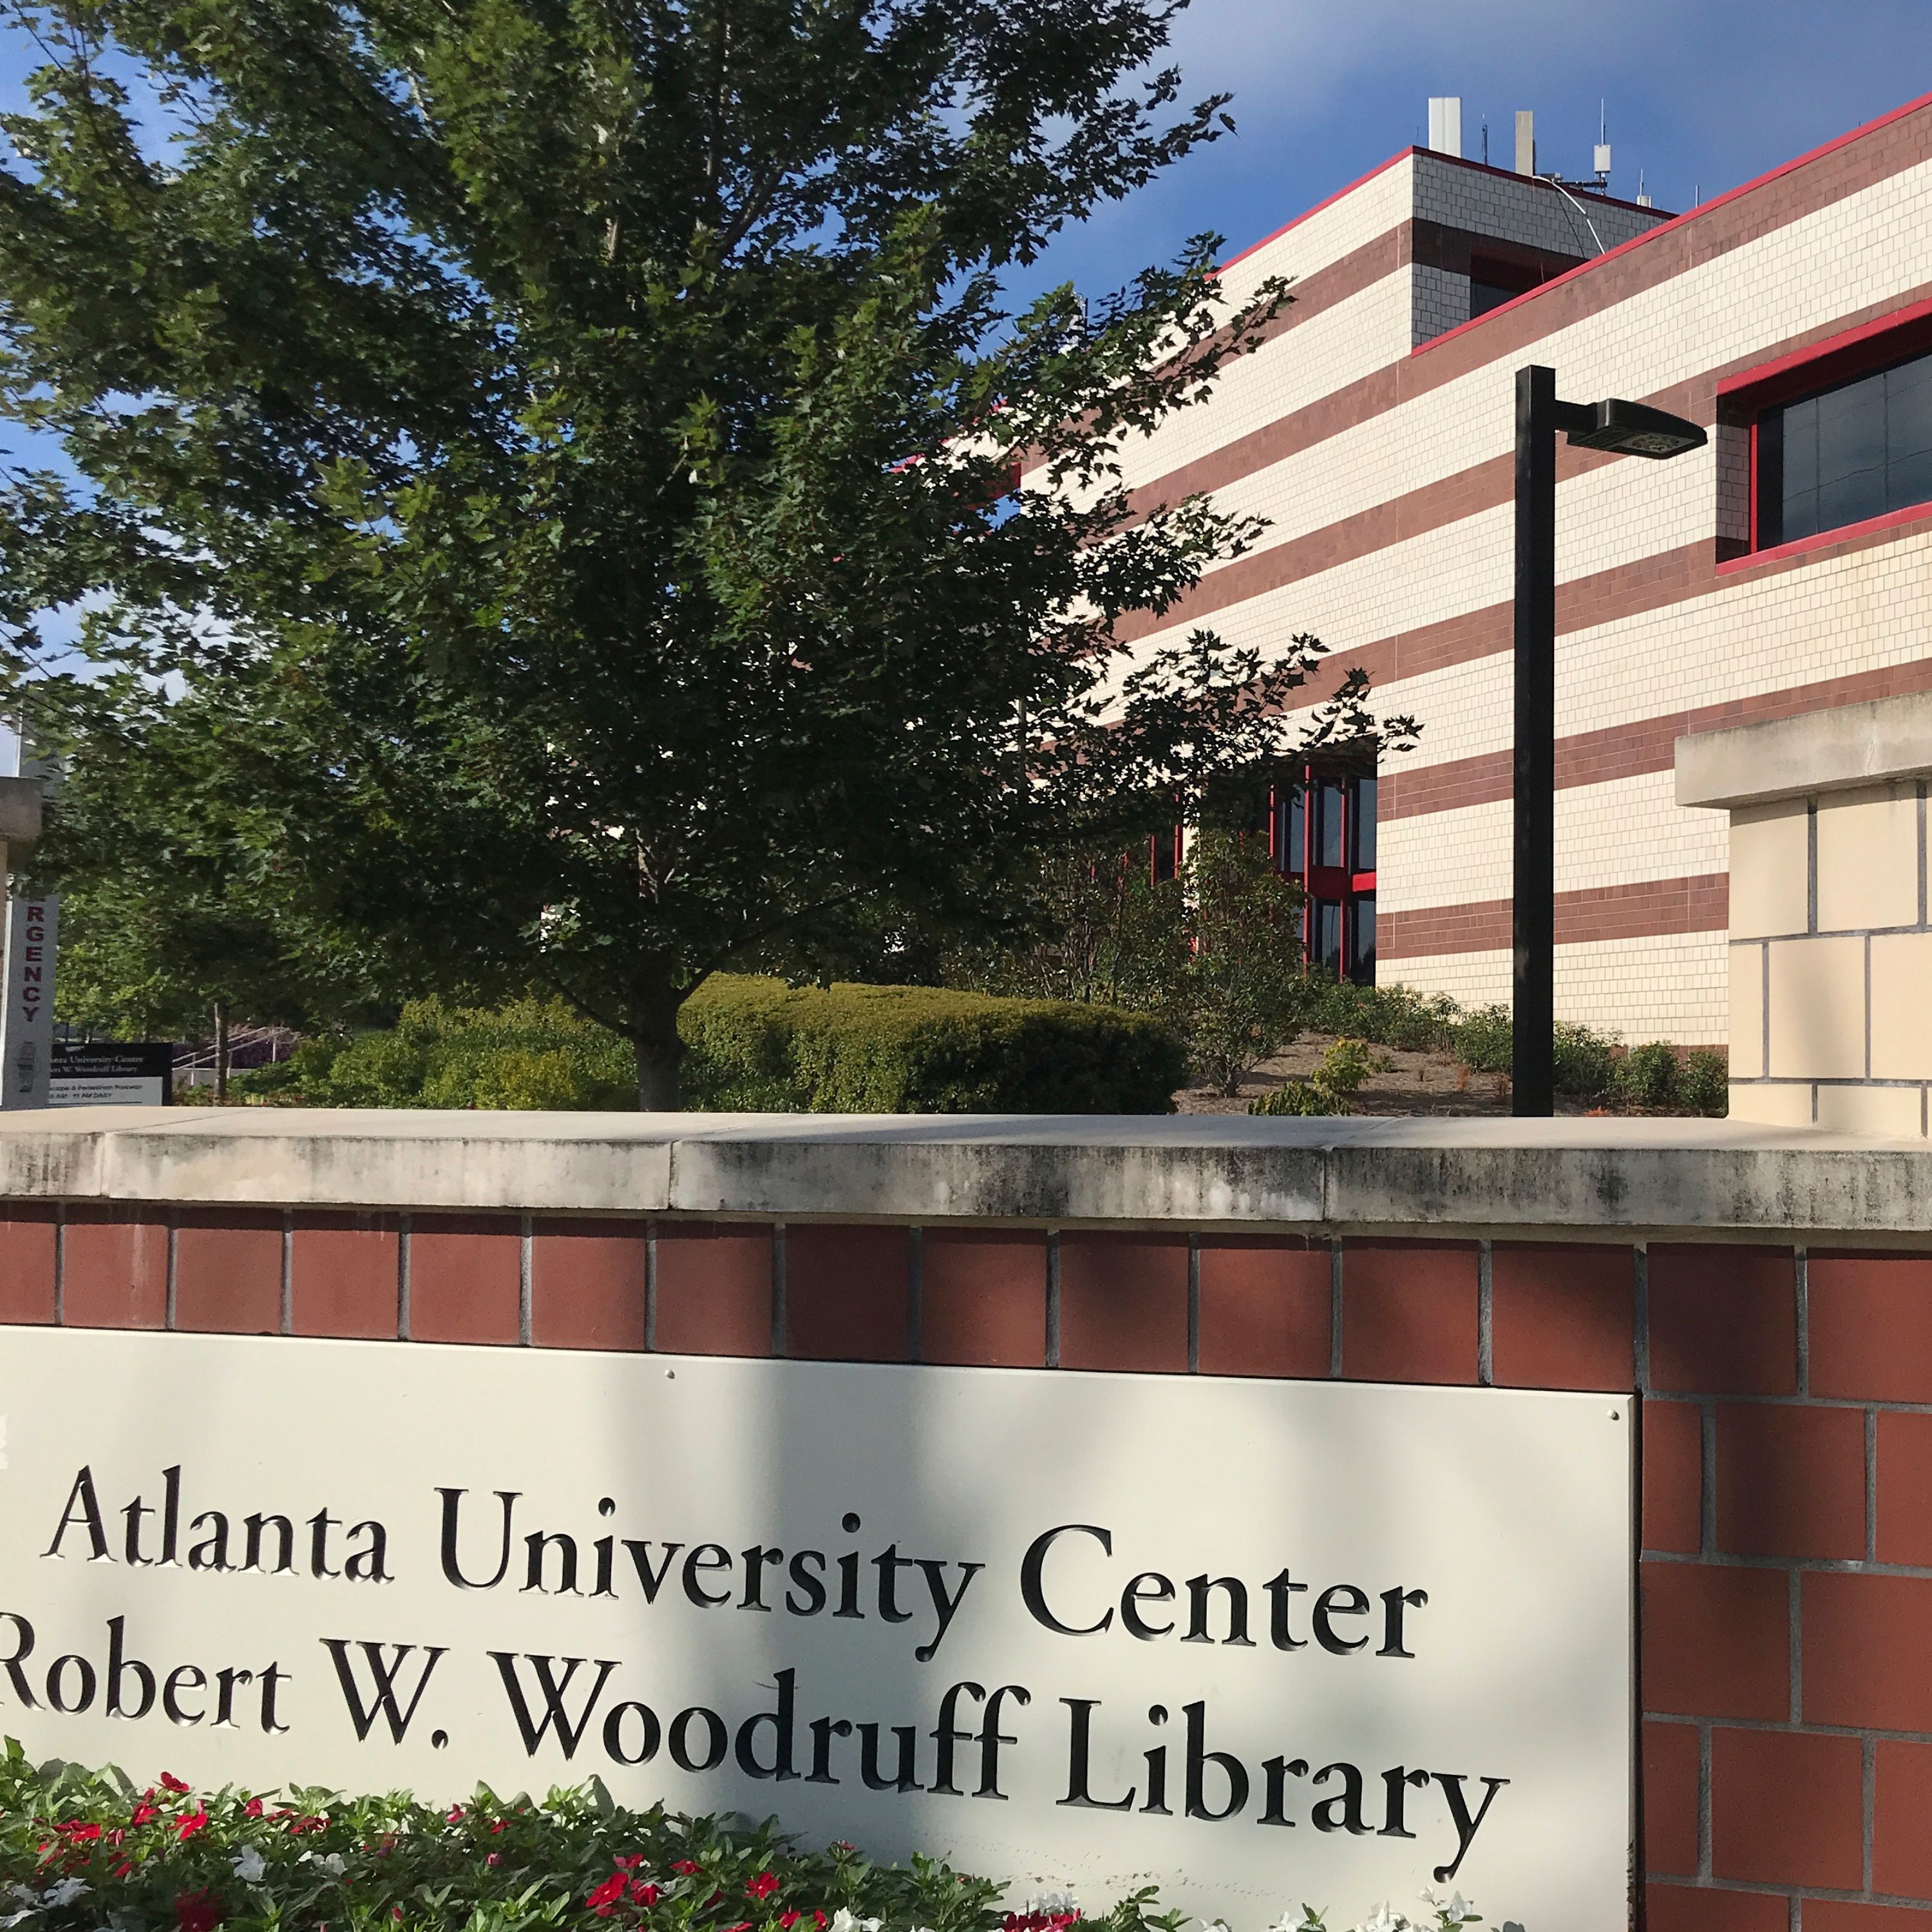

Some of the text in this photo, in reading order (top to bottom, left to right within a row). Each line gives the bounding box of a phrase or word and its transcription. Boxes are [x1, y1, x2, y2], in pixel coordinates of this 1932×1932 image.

[22, 898, 45, 1023] RGENCY
[70, 1056, 113, 1065] University
[41, 1464, 1428, 1663] Atlanta University Center
[0, 1611, 1510, 1884] Robert W. Woodruff Library
